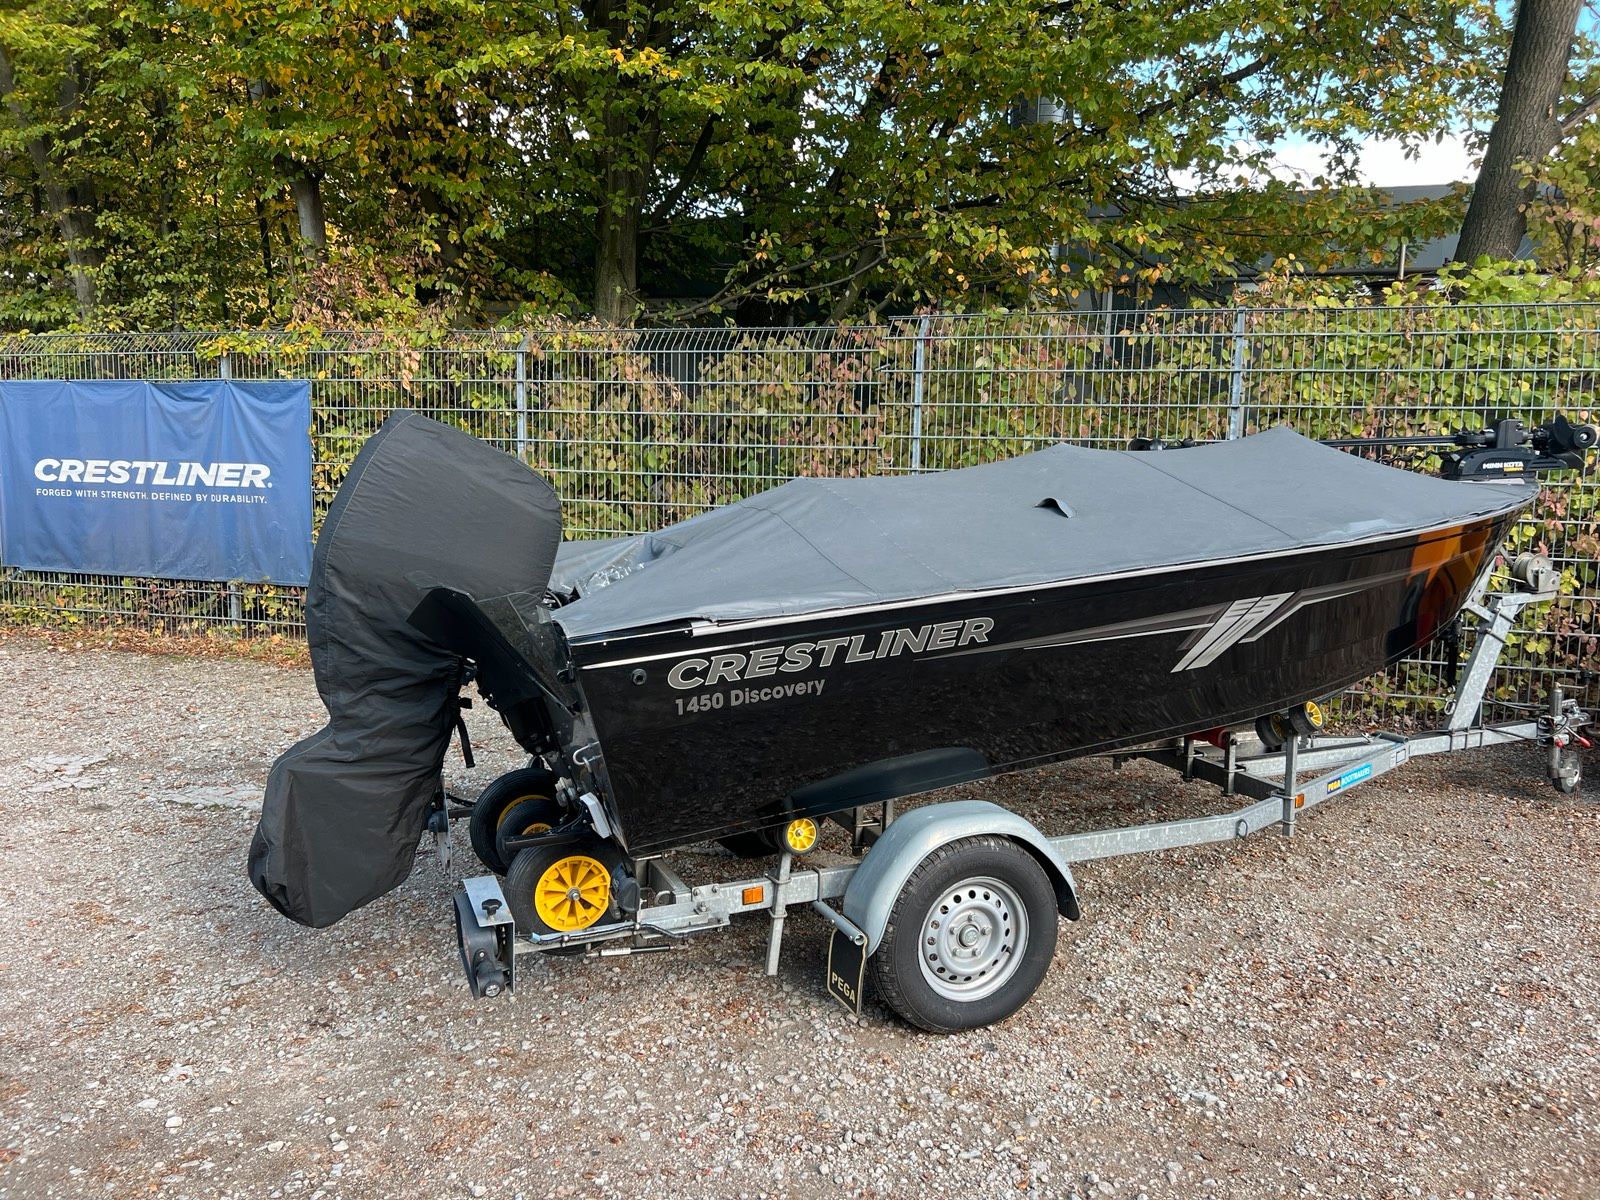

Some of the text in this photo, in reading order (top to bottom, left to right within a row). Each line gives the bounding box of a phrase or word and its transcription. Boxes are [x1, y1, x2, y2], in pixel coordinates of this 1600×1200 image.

[36, 488, 268, 505] FORGED WITH STRENGTH. DEFINED BY DURABILITY.
[667, 617, 995, 690] CRESTLINER
[675, 679, 826, 716] 1450 Discovery
[832, 971, 856, 1004] PEGA
